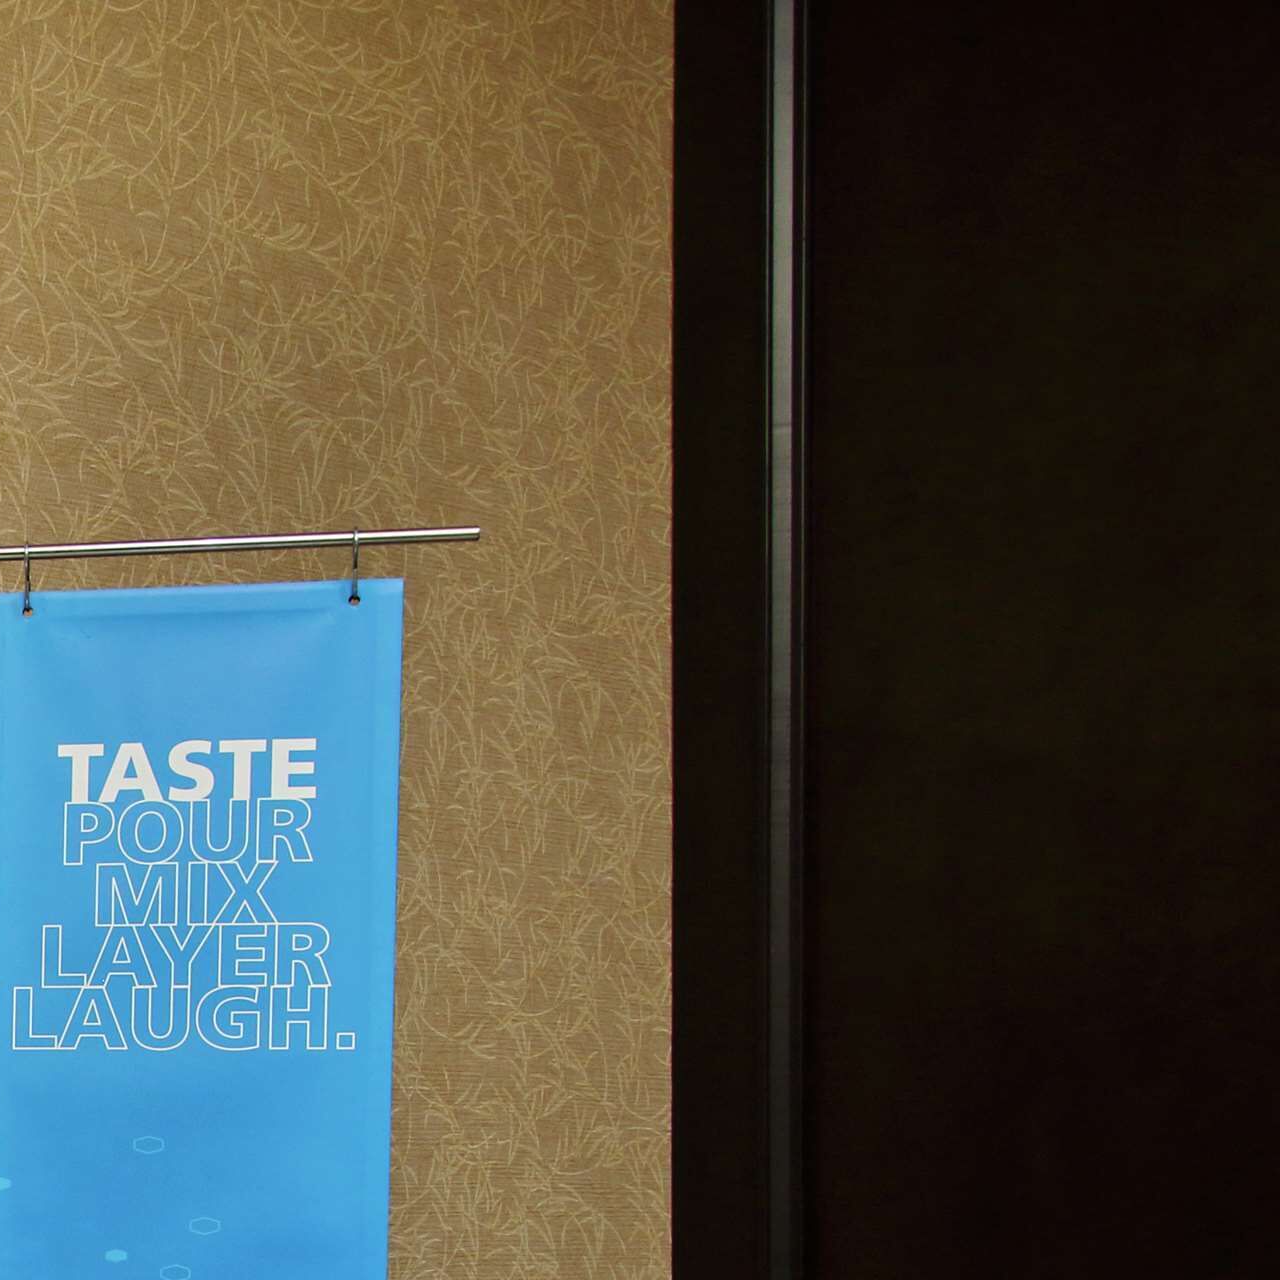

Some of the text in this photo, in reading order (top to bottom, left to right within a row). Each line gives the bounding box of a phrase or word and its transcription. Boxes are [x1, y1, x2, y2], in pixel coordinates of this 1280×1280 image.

[57, 738, 317, 802] TASTE
[63, 798, 313, 865] POUR
[95, 861, 278, 926] MIX
[42, 922, 331, 988] LAYER
[12, 985, 356, 1051] LAUGH.
